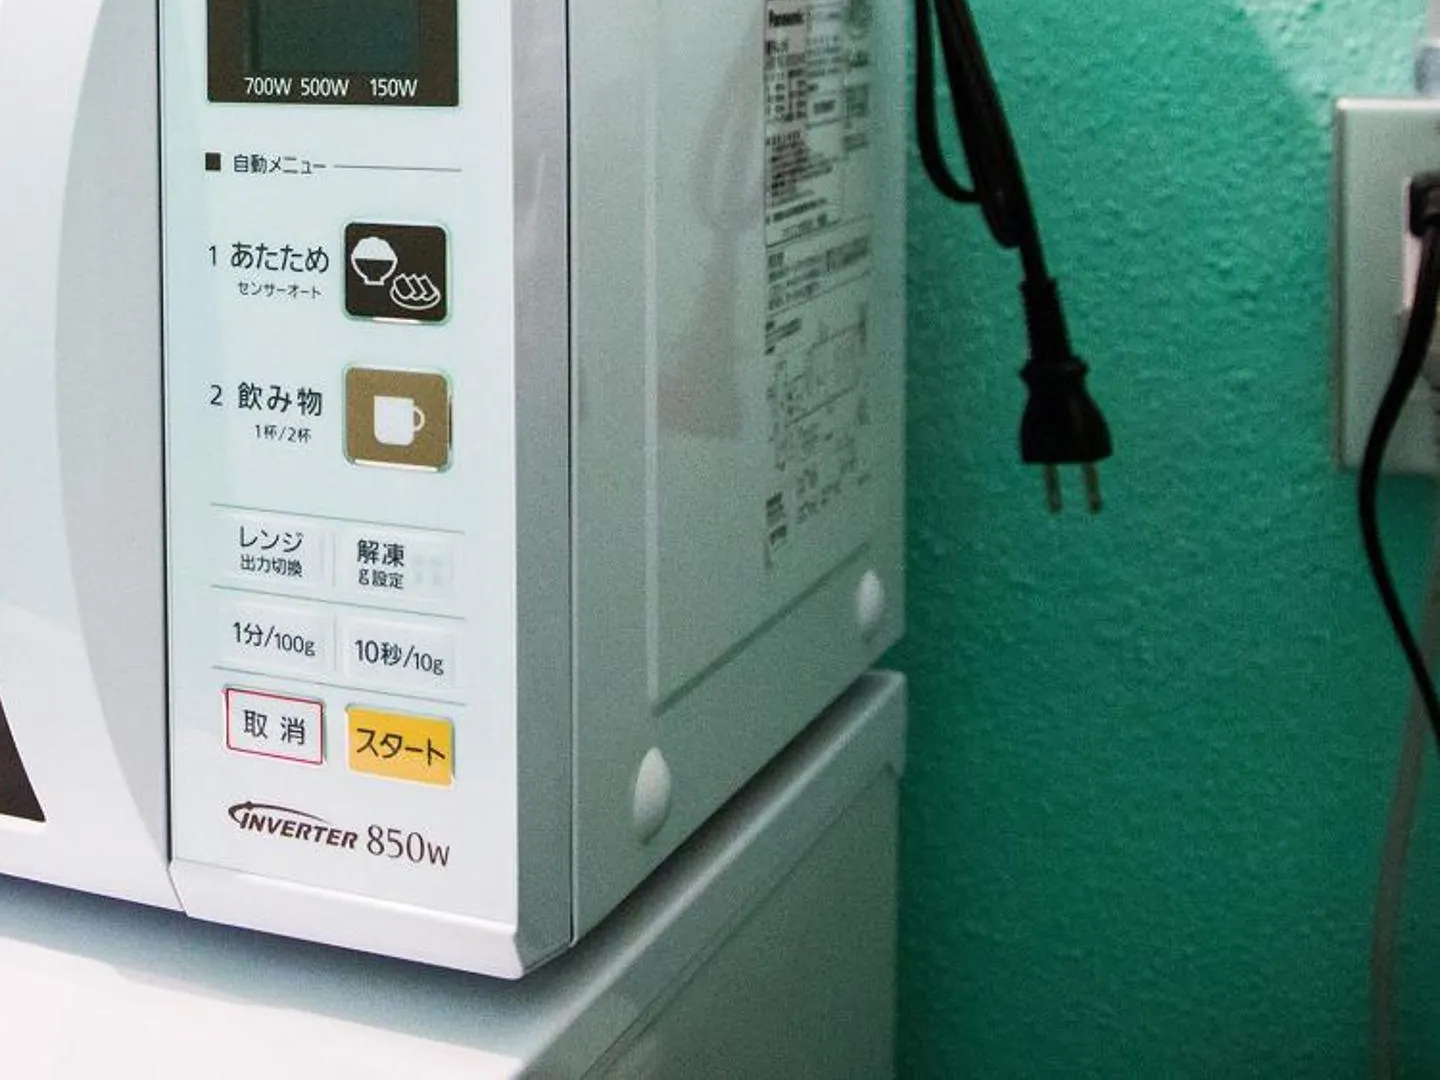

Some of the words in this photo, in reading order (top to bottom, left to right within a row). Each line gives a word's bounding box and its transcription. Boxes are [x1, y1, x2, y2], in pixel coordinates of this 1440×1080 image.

[244, 77, 293, 97] 700W
[300, 78, 350, 97] 500W
[370, 78, 419, 98] 150W
[232, 153, 327, 175] 自動メニュー
[208, 245, 218, 267] 1
[230, 241, 330, 274] あたため
[237, 280, 322, 300] センサーオート
[209, 384, 223, 407] 2
[237, 381, 323, 417] 飲み物
[240, 525, 304, 553] レンジ
[357, 538, 405, 568] 解凍
[240, 553, 303, 579] 出力切換
[232, 621, 316, 657] 1分/100g
[354, 638, 445, 676] 10秒/10g
[356, 727, 447, 766] スタート
[237, 809, 359, 850] INVERTER
